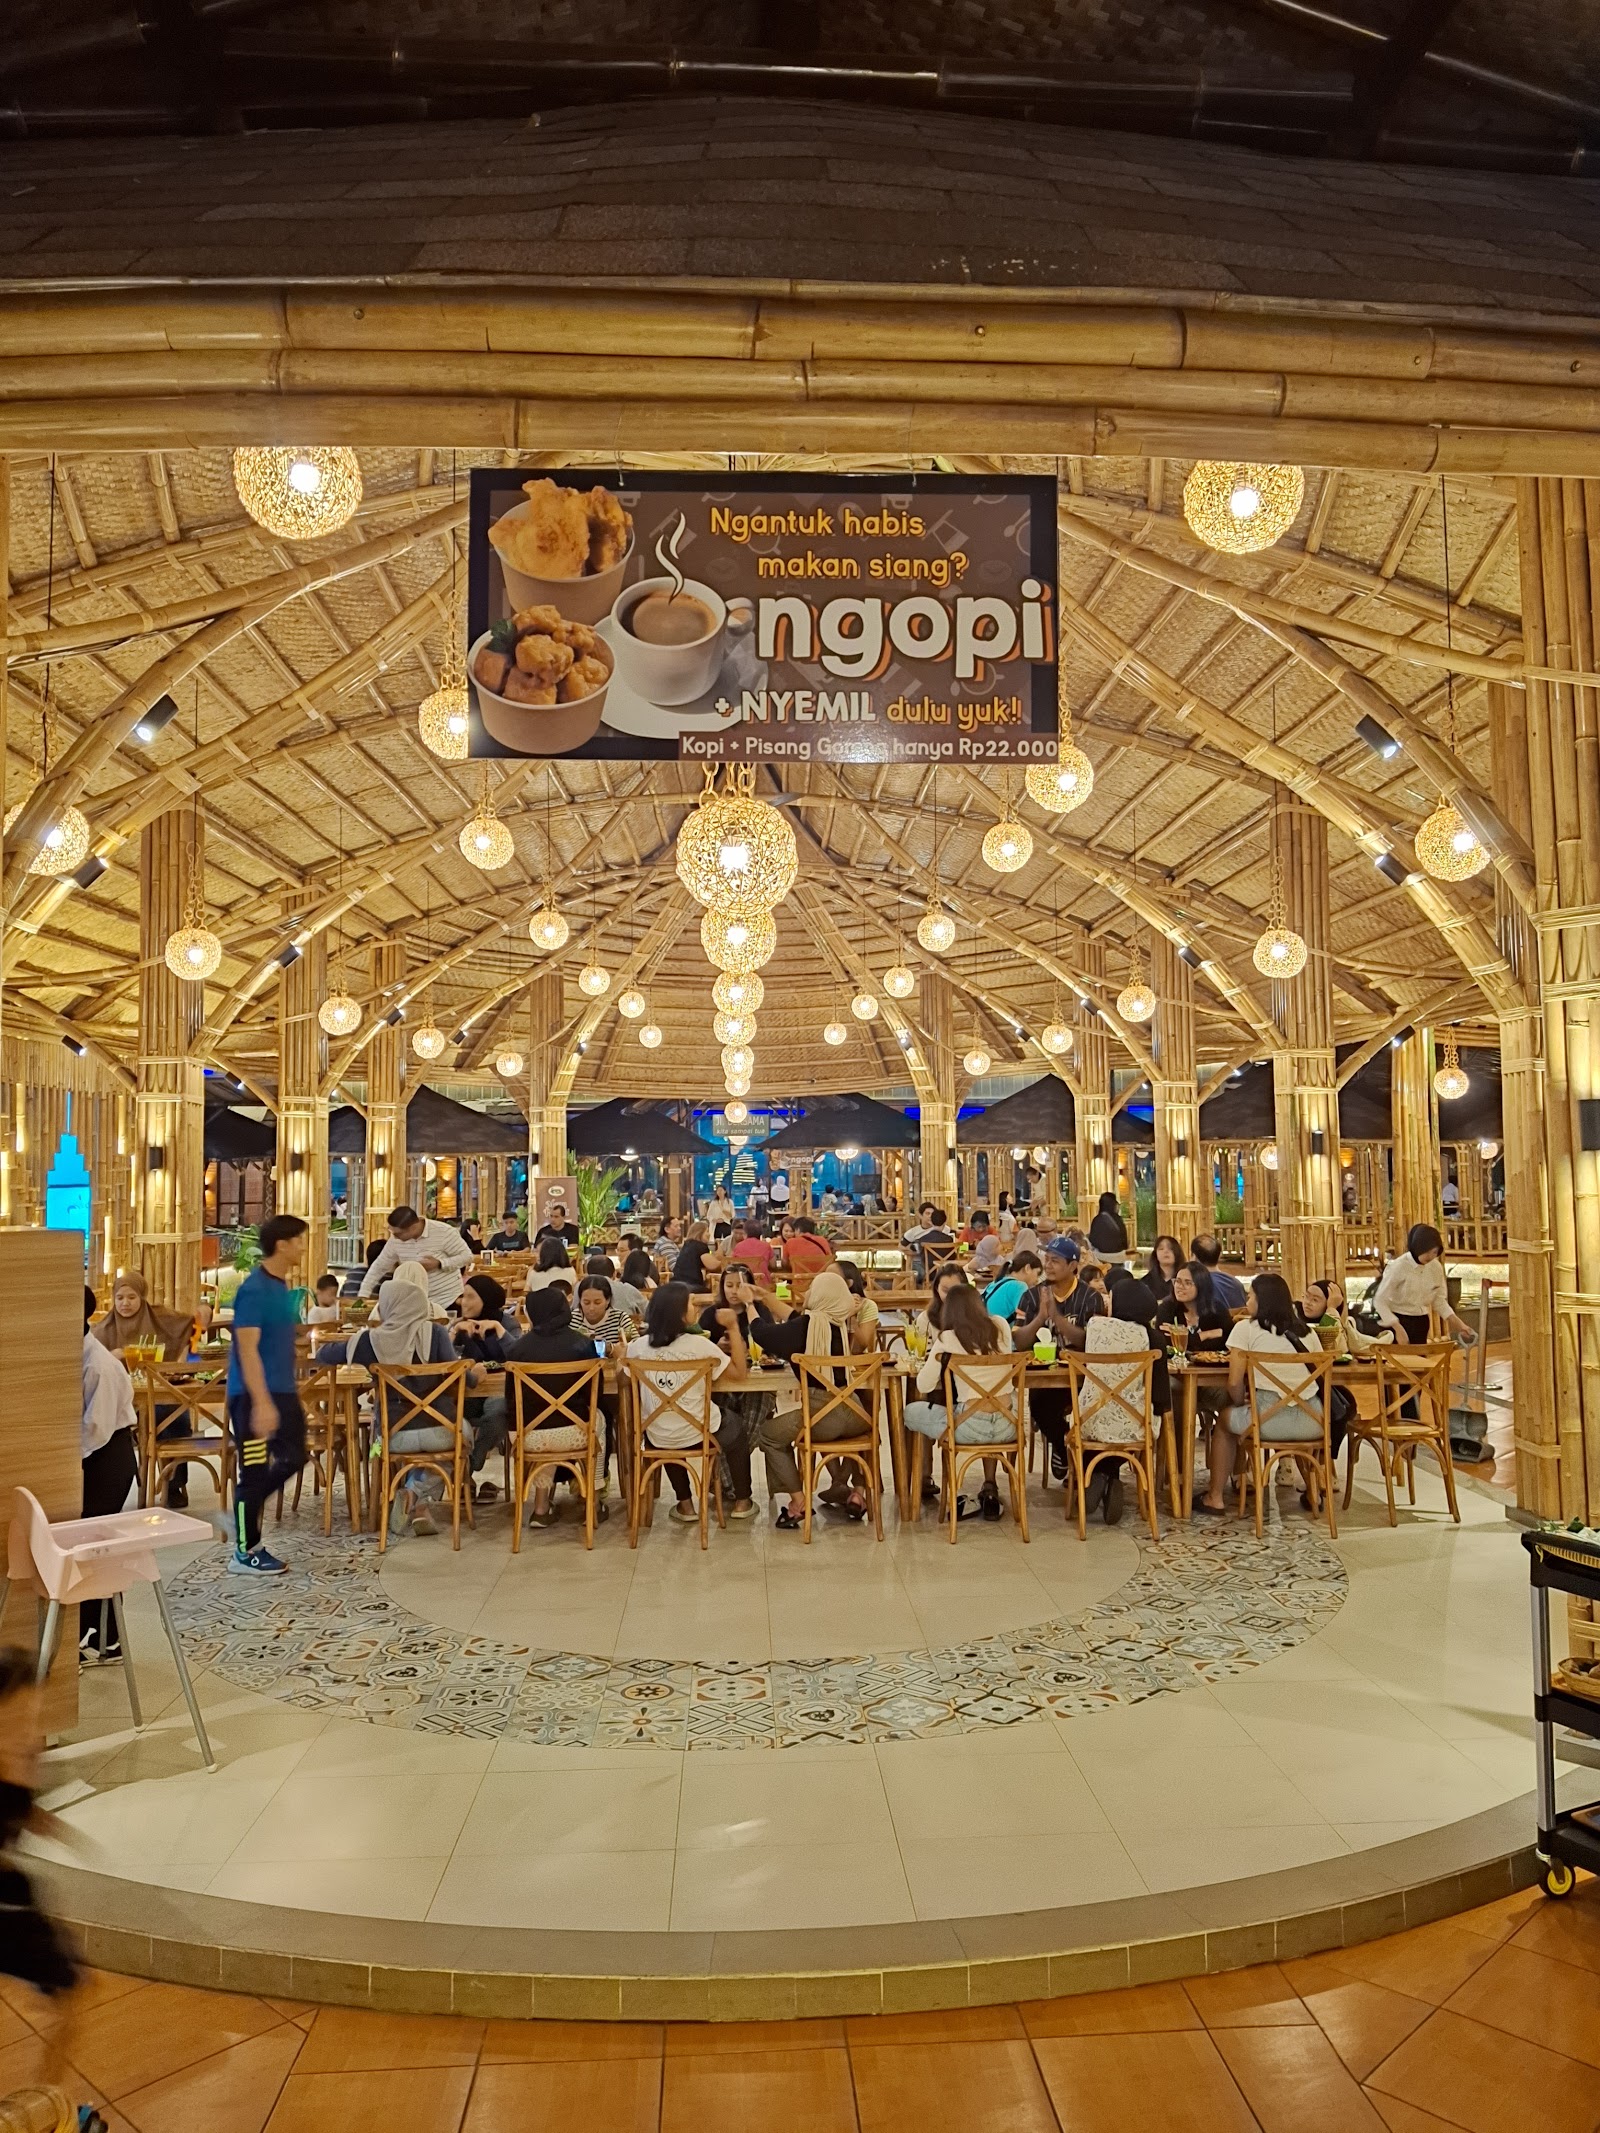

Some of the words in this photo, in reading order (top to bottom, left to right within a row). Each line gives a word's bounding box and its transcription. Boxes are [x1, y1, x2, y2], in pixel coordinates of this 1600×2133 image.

[710, 507, 834, 543] Ngantuk
[844, 509, 926, 536] habis
[758, 551, 859, 578] makan
[869, 552, 968, 587] siang?
[758, 578, 1049, 680] ngopi
[741, 690, 877, 723] NYEMIL
[886, 695, 949, 723] dulu
[957, 696, 1020, 732] yuk!
[682, 736, 724, 759] Kopi
[745, 737, 811, 760] Pisang
[893, 738, 953, 760] hanya
[959, 738, 1058, 760] Rp22.000
[790, 1155, 814, 1164] ngopi
